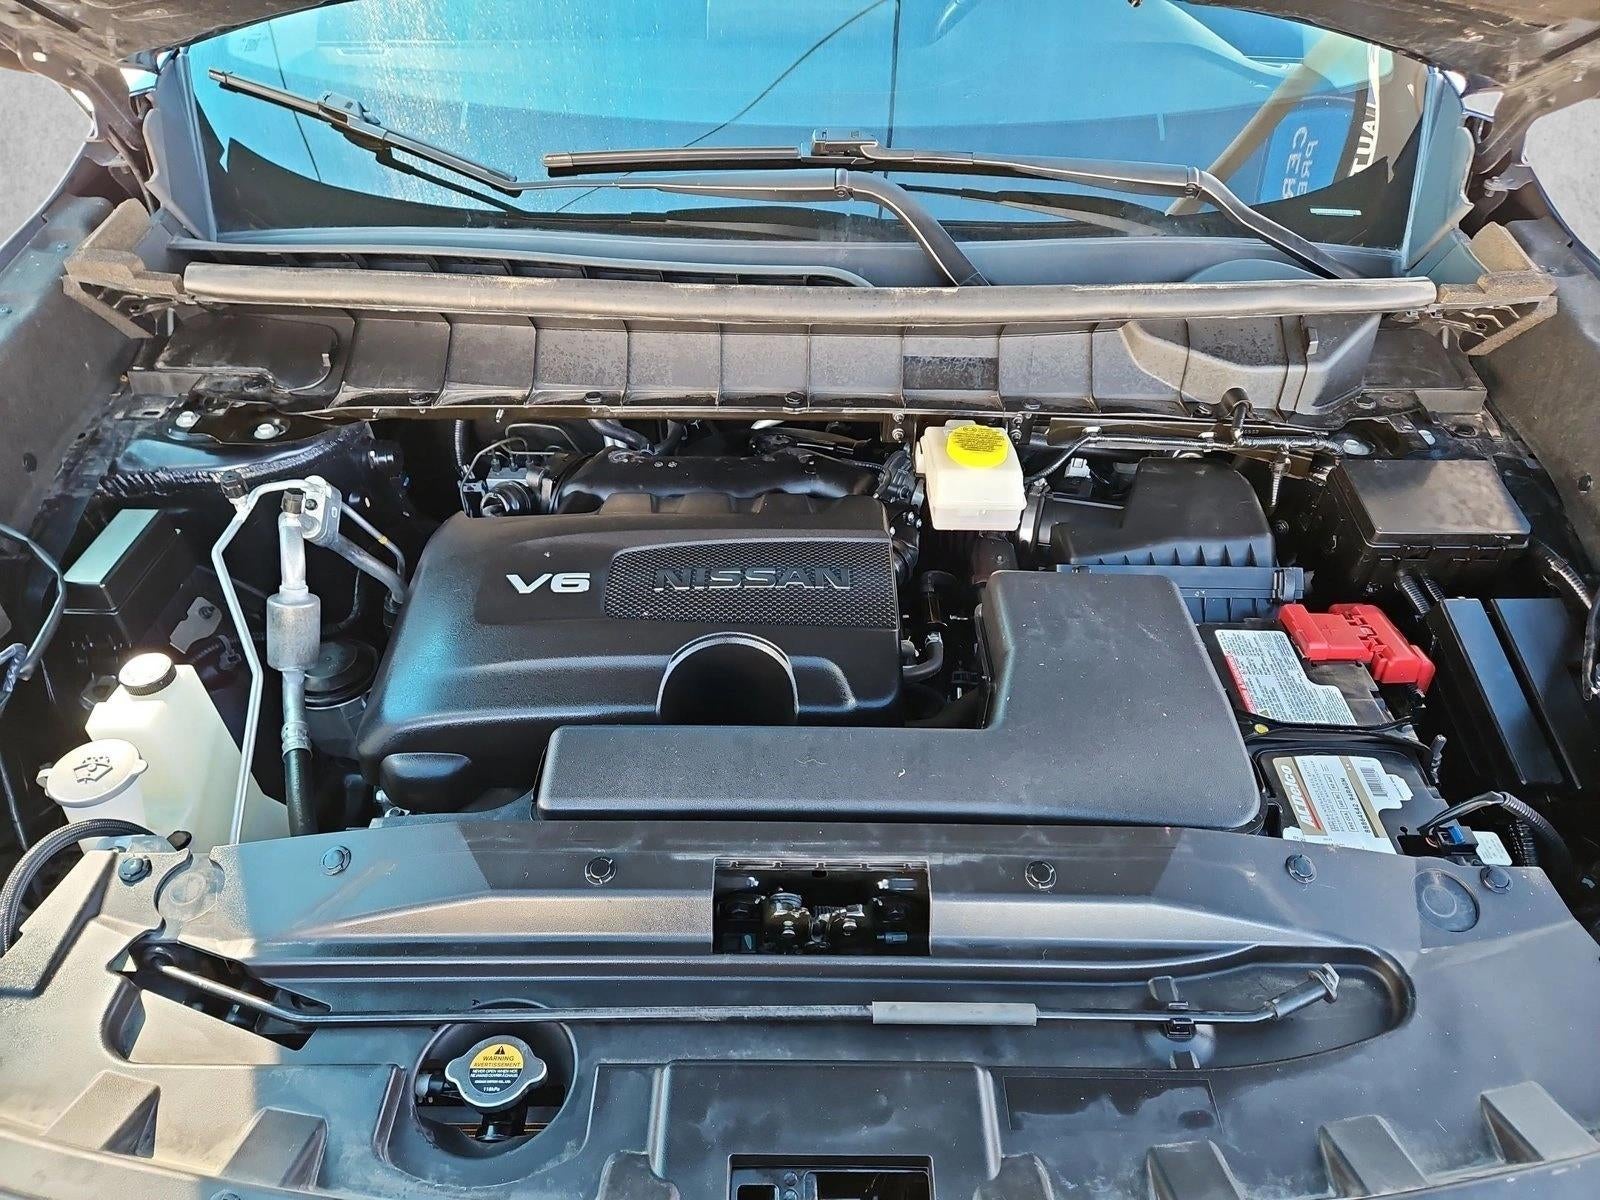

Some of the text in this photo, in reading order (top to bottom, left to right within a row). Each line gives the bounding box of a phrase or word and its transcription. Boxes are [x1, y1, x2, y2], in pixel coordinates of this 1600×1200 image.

[506, 572, 591, 594] V6
[653, 567, 851, 592] NISSAN
[1279, 764, 1315, 827] ACDelco
